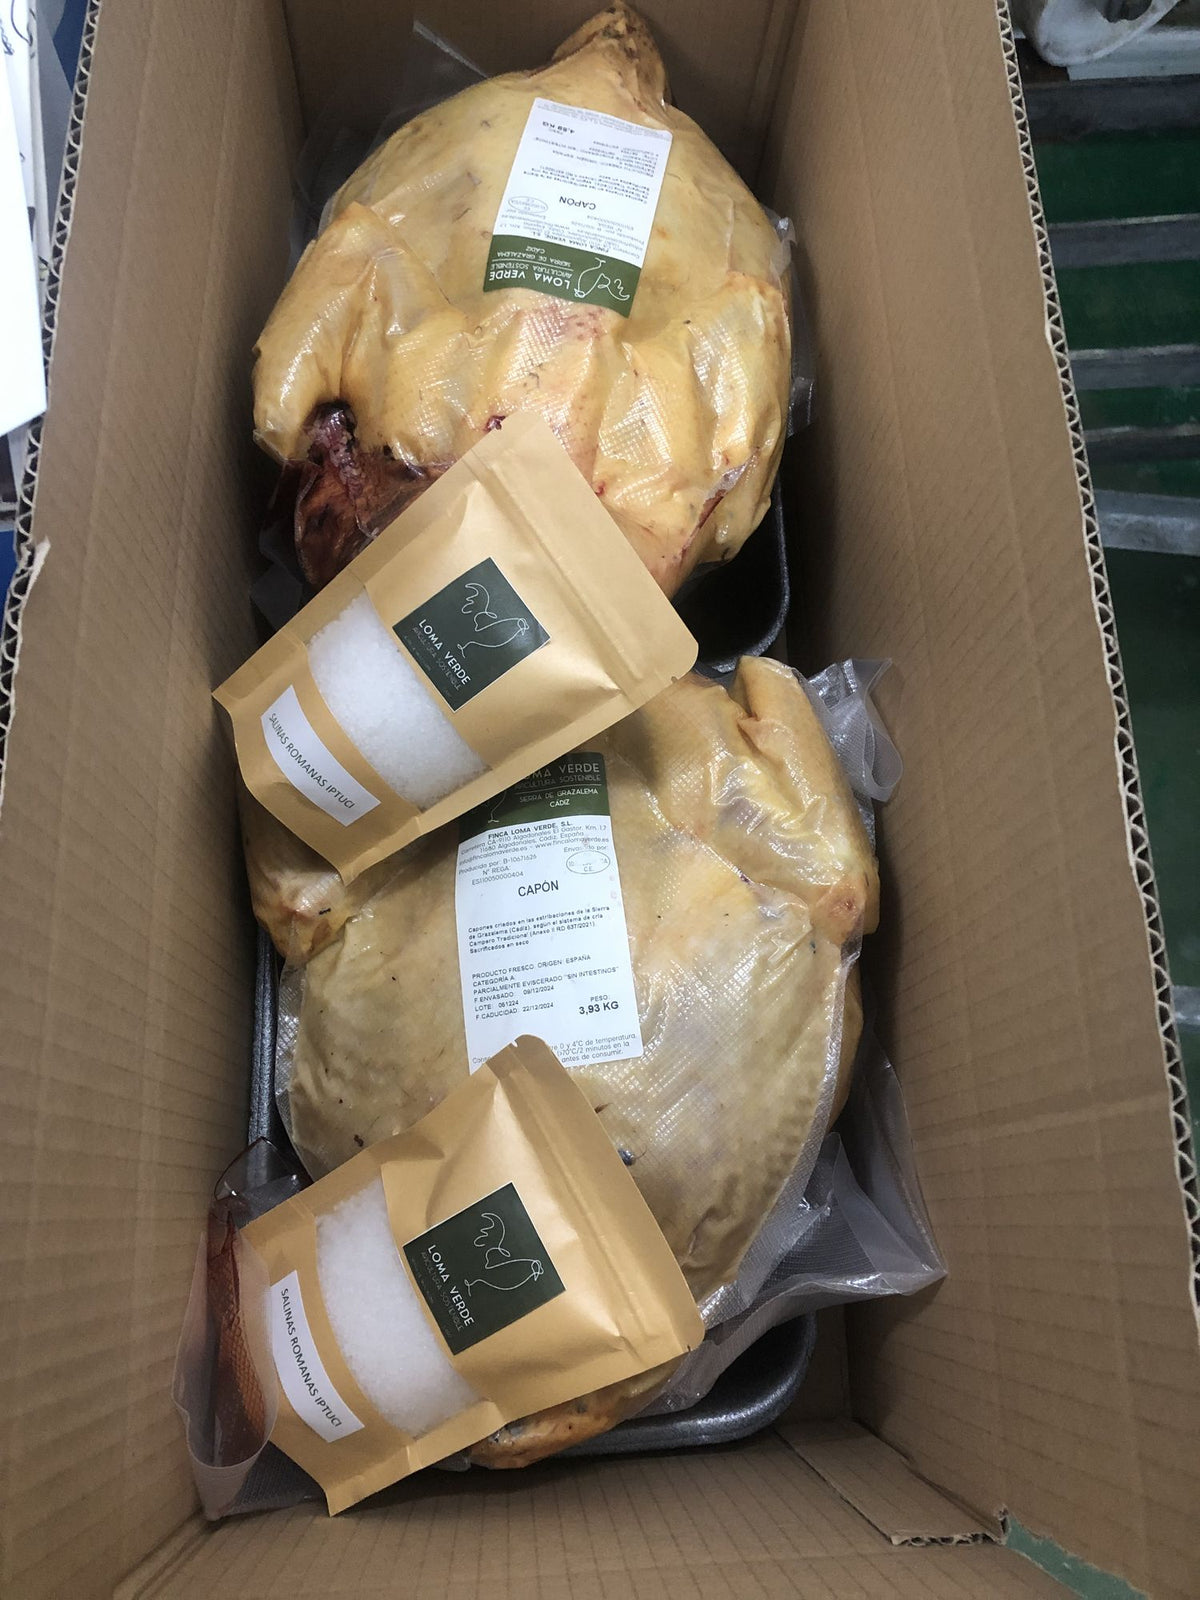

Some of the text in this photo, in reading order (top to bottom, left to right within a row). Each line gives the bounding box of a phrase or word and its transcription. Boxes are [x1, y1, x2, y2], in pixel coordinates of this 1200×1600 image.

[559, 196, 596, 210] CAPÓN
[490, 262, 572, 278] AVICULTURA SOSTENIBLE
[550, 258, 571, 267] SIERRA
[489, 270, 570, 289] LOMA VERDE
[419, 619, 443, 650] LOMA
[445, 651, 471, 685] VERDE
[269, 713, 355, 809] SALINAS ROMANAS IPTUCI
[559, 763, 600, 774] VERDE
[520, 793, 543, 803] SIERRA
[557, 788, 598, 796] GRAZALEMA
[550, 798, 570, 808] CÁDIZ
[488, 831, 508, 839] FINCA
[511, 827, 531, 836] LOMA
[518, 879, 559, 897] CAPÓN
[472, 969, 507, 979] PRODUCTO
[565, 954, 591, 964] ESPAÑA
[474, 982, 520, 995] PARCIALMENTE
[523, 975, 563, 987] EVISCERADO
[579, 1001, 619, 1016] 3,93 KG
[585, 1044, 611, 1054] minutos
[561, 1055, 580, 1063] antes
[581, 1053, 590, 1061] de
[428, 1245, 450, 1282] LOMA
[450, 1286, 474, 1326] VERDE
[281, 1288, 342, 1427] SALINAS ROMANAS IPTUCI
